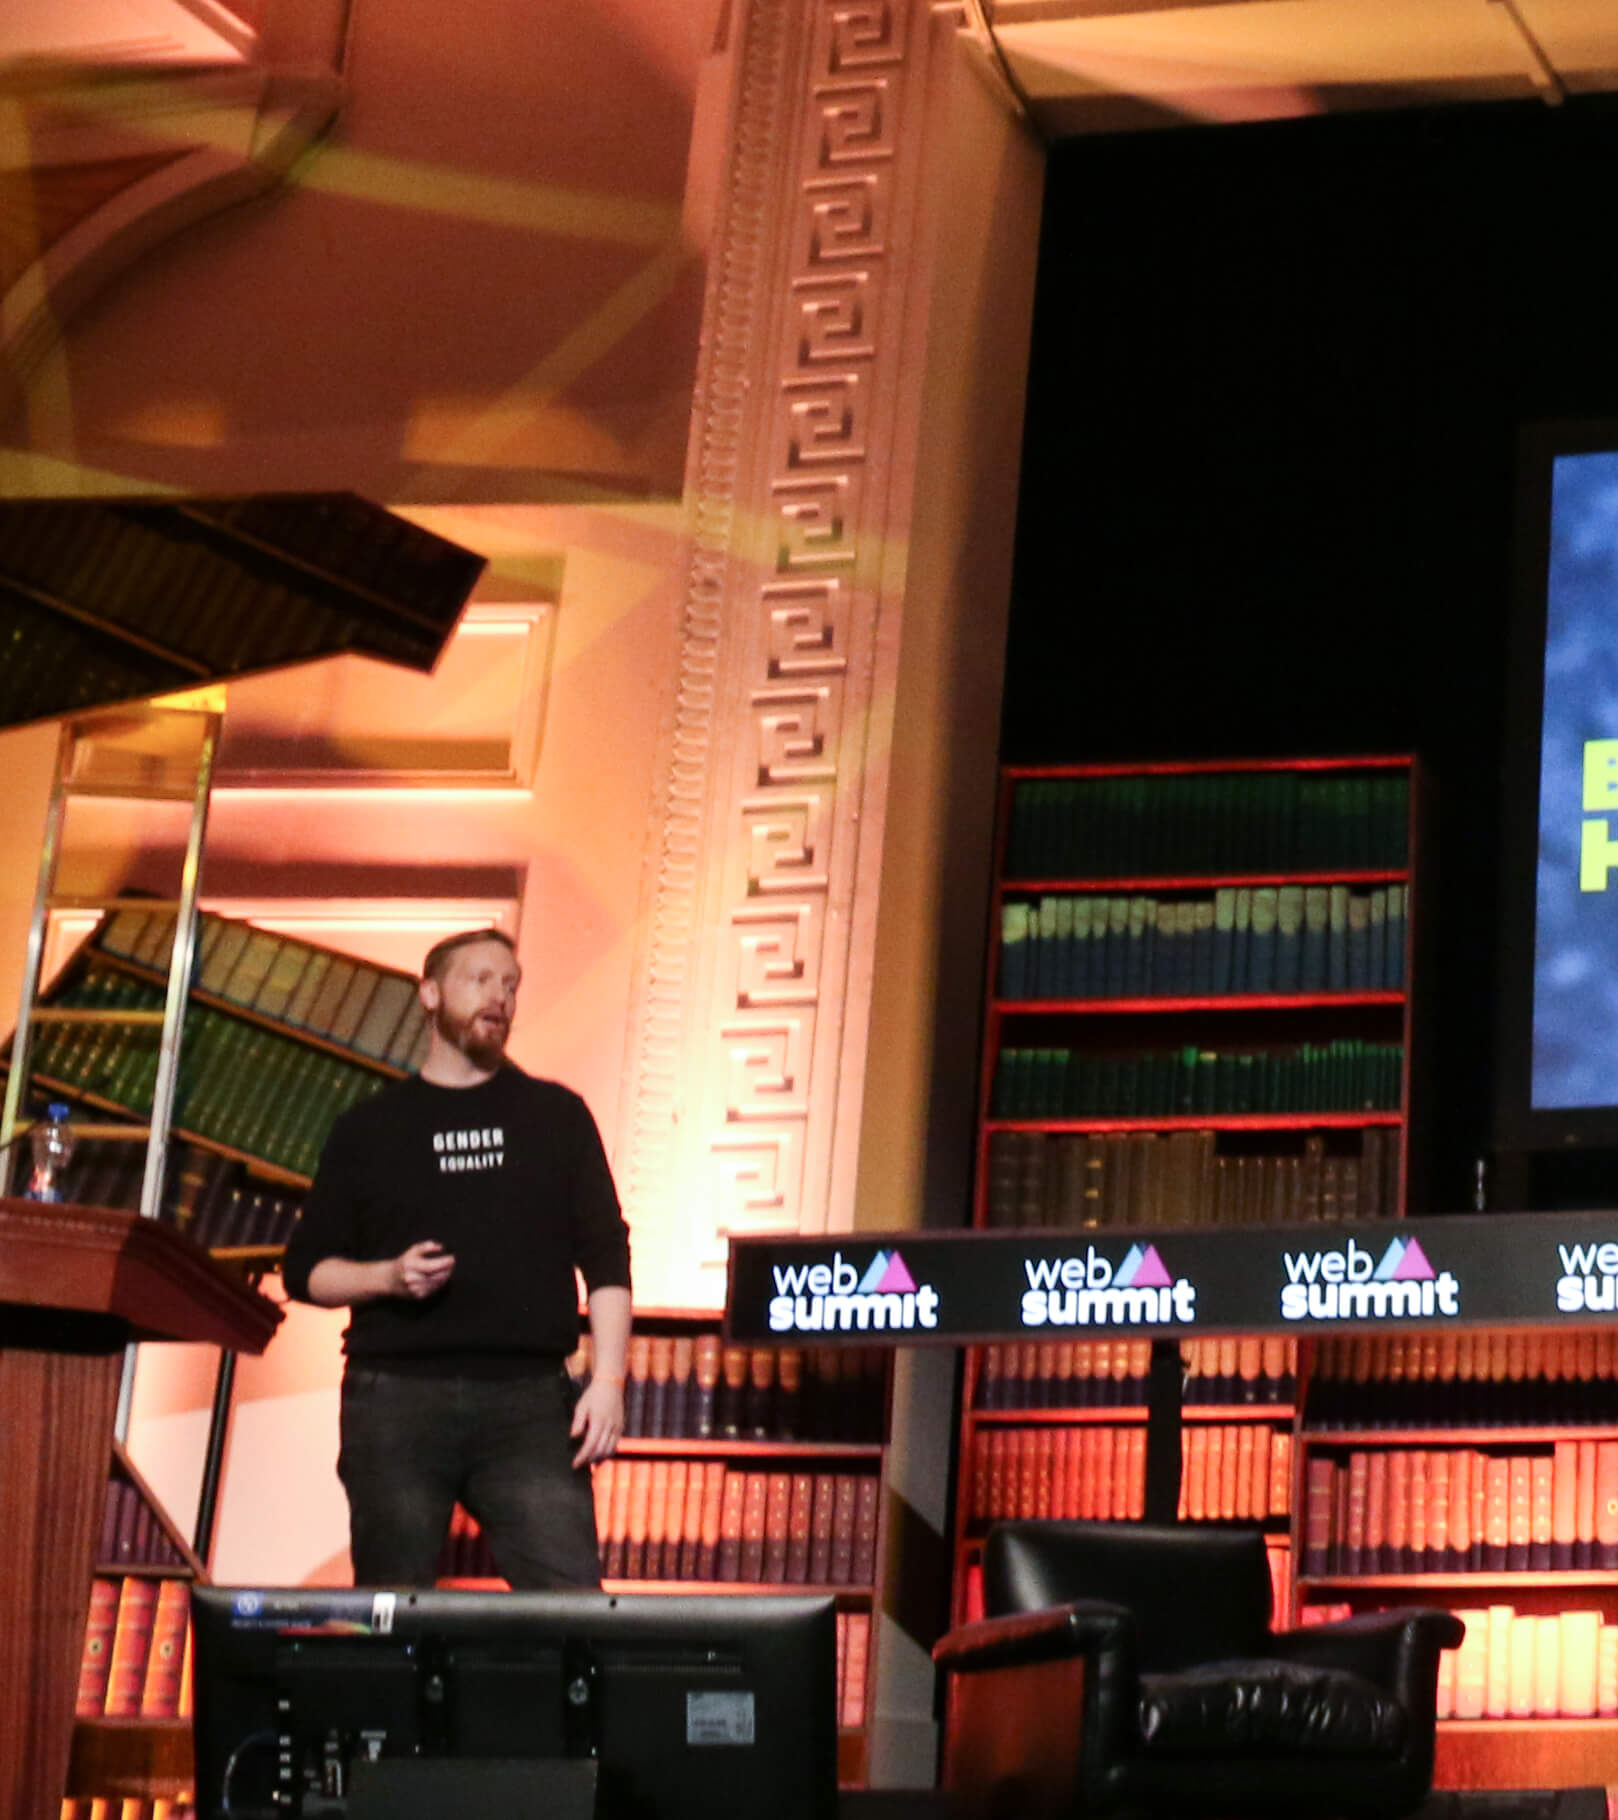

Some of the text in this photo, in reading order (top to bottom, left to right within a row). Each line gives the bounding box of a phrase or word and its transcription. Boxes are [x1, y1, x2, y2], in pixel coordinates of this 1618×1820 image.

[432, 1127, 504, 1152] GENDER
[440, 1152, 504, 1172] EQUALITY
[773, 1252, 858, 1297] web
[1023, 1246, 1112, 1290] web
[1283, 1239, 1373, 1284] web
[769, 1285, 938, 1330] summit
[1021, 1279, 1195, 1325] summit
[1281, 1272, 1459, 1319] summit
